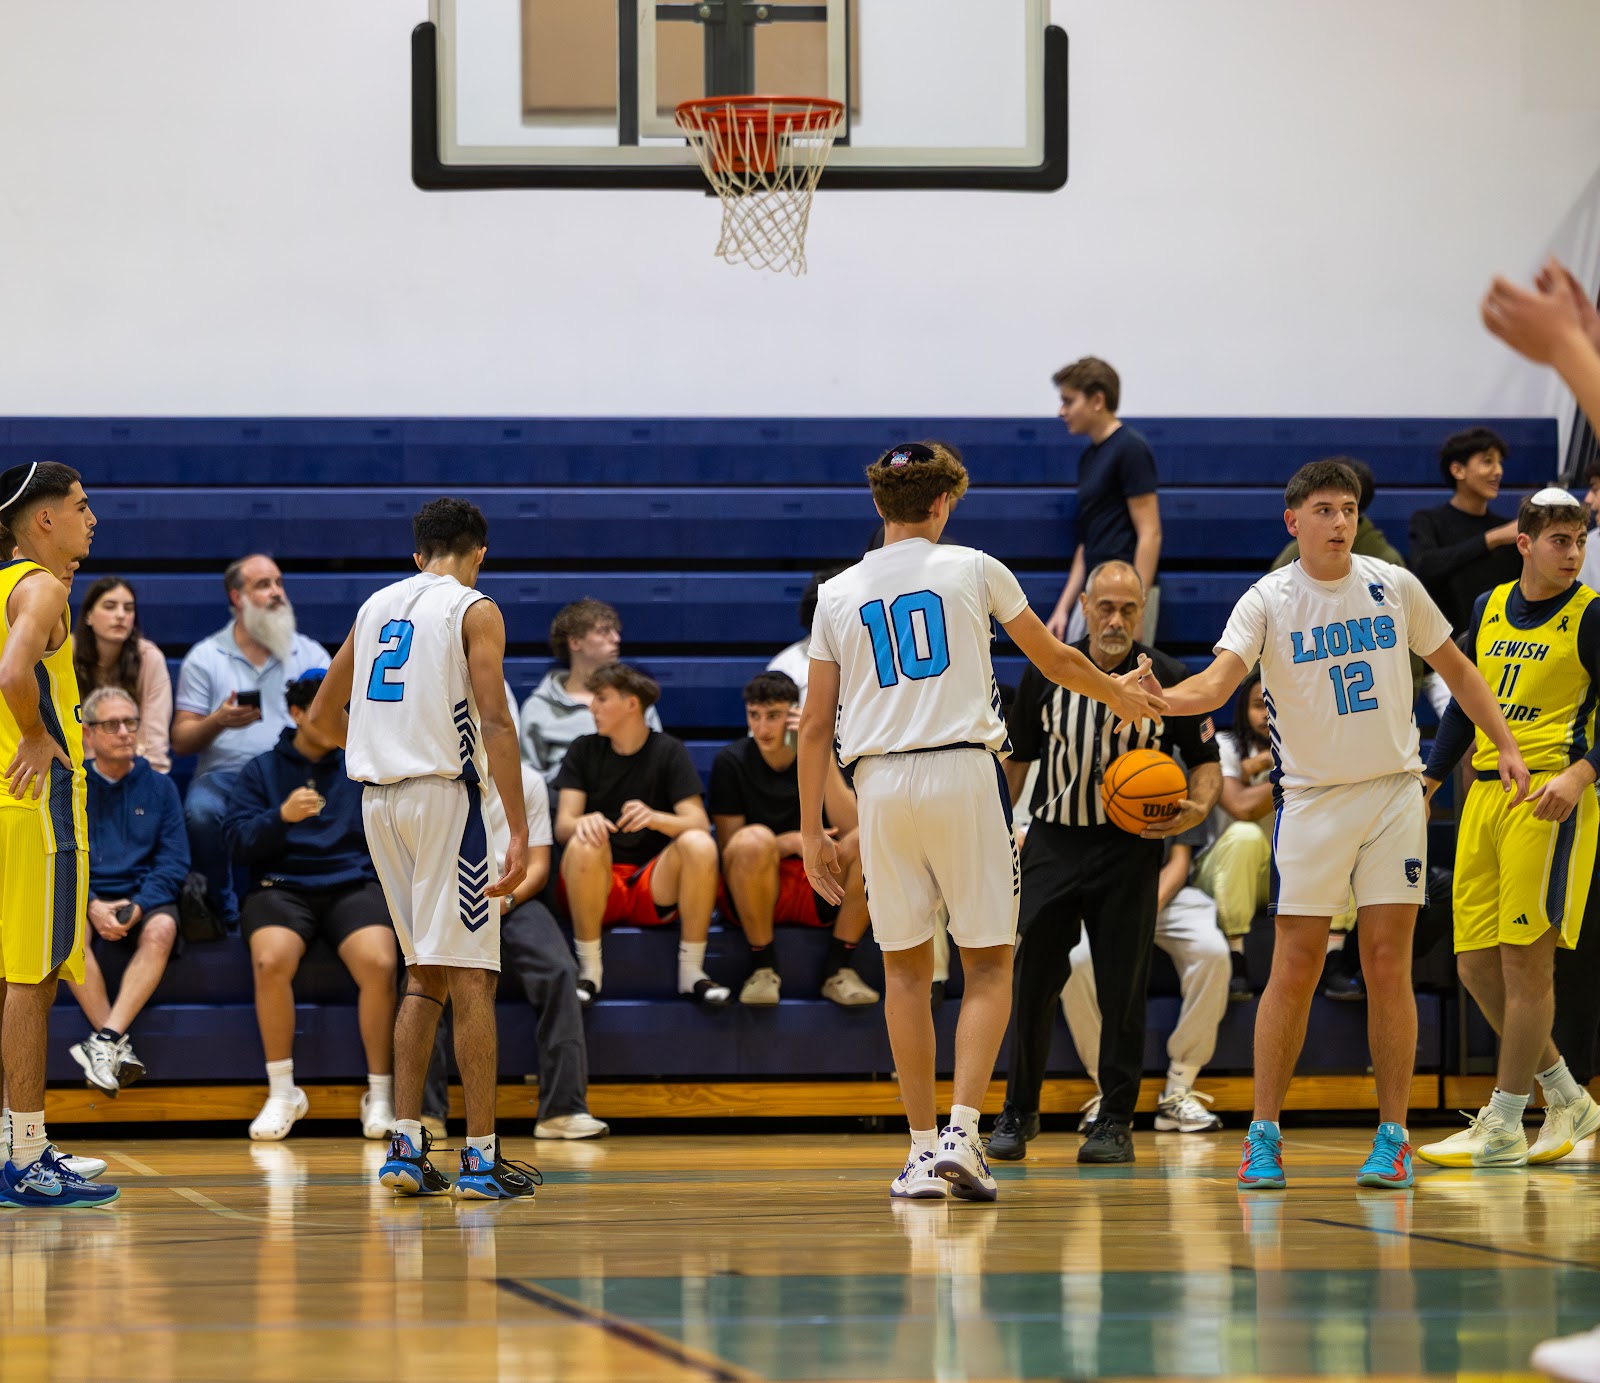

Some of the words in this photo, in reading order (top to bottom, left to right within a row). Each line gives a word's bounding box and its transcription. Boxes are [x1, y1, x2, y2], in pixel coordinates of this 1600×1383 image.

[366, 618, 415, 702] 2
[859, 589, 951, 689] 10
[1290, 614, 1397, 664] LIONS
[1484, 640, 1550, 662] JEWISH
[1328, 660, 1379, 716] 12
[1496, 663, 1522, 698] 11
